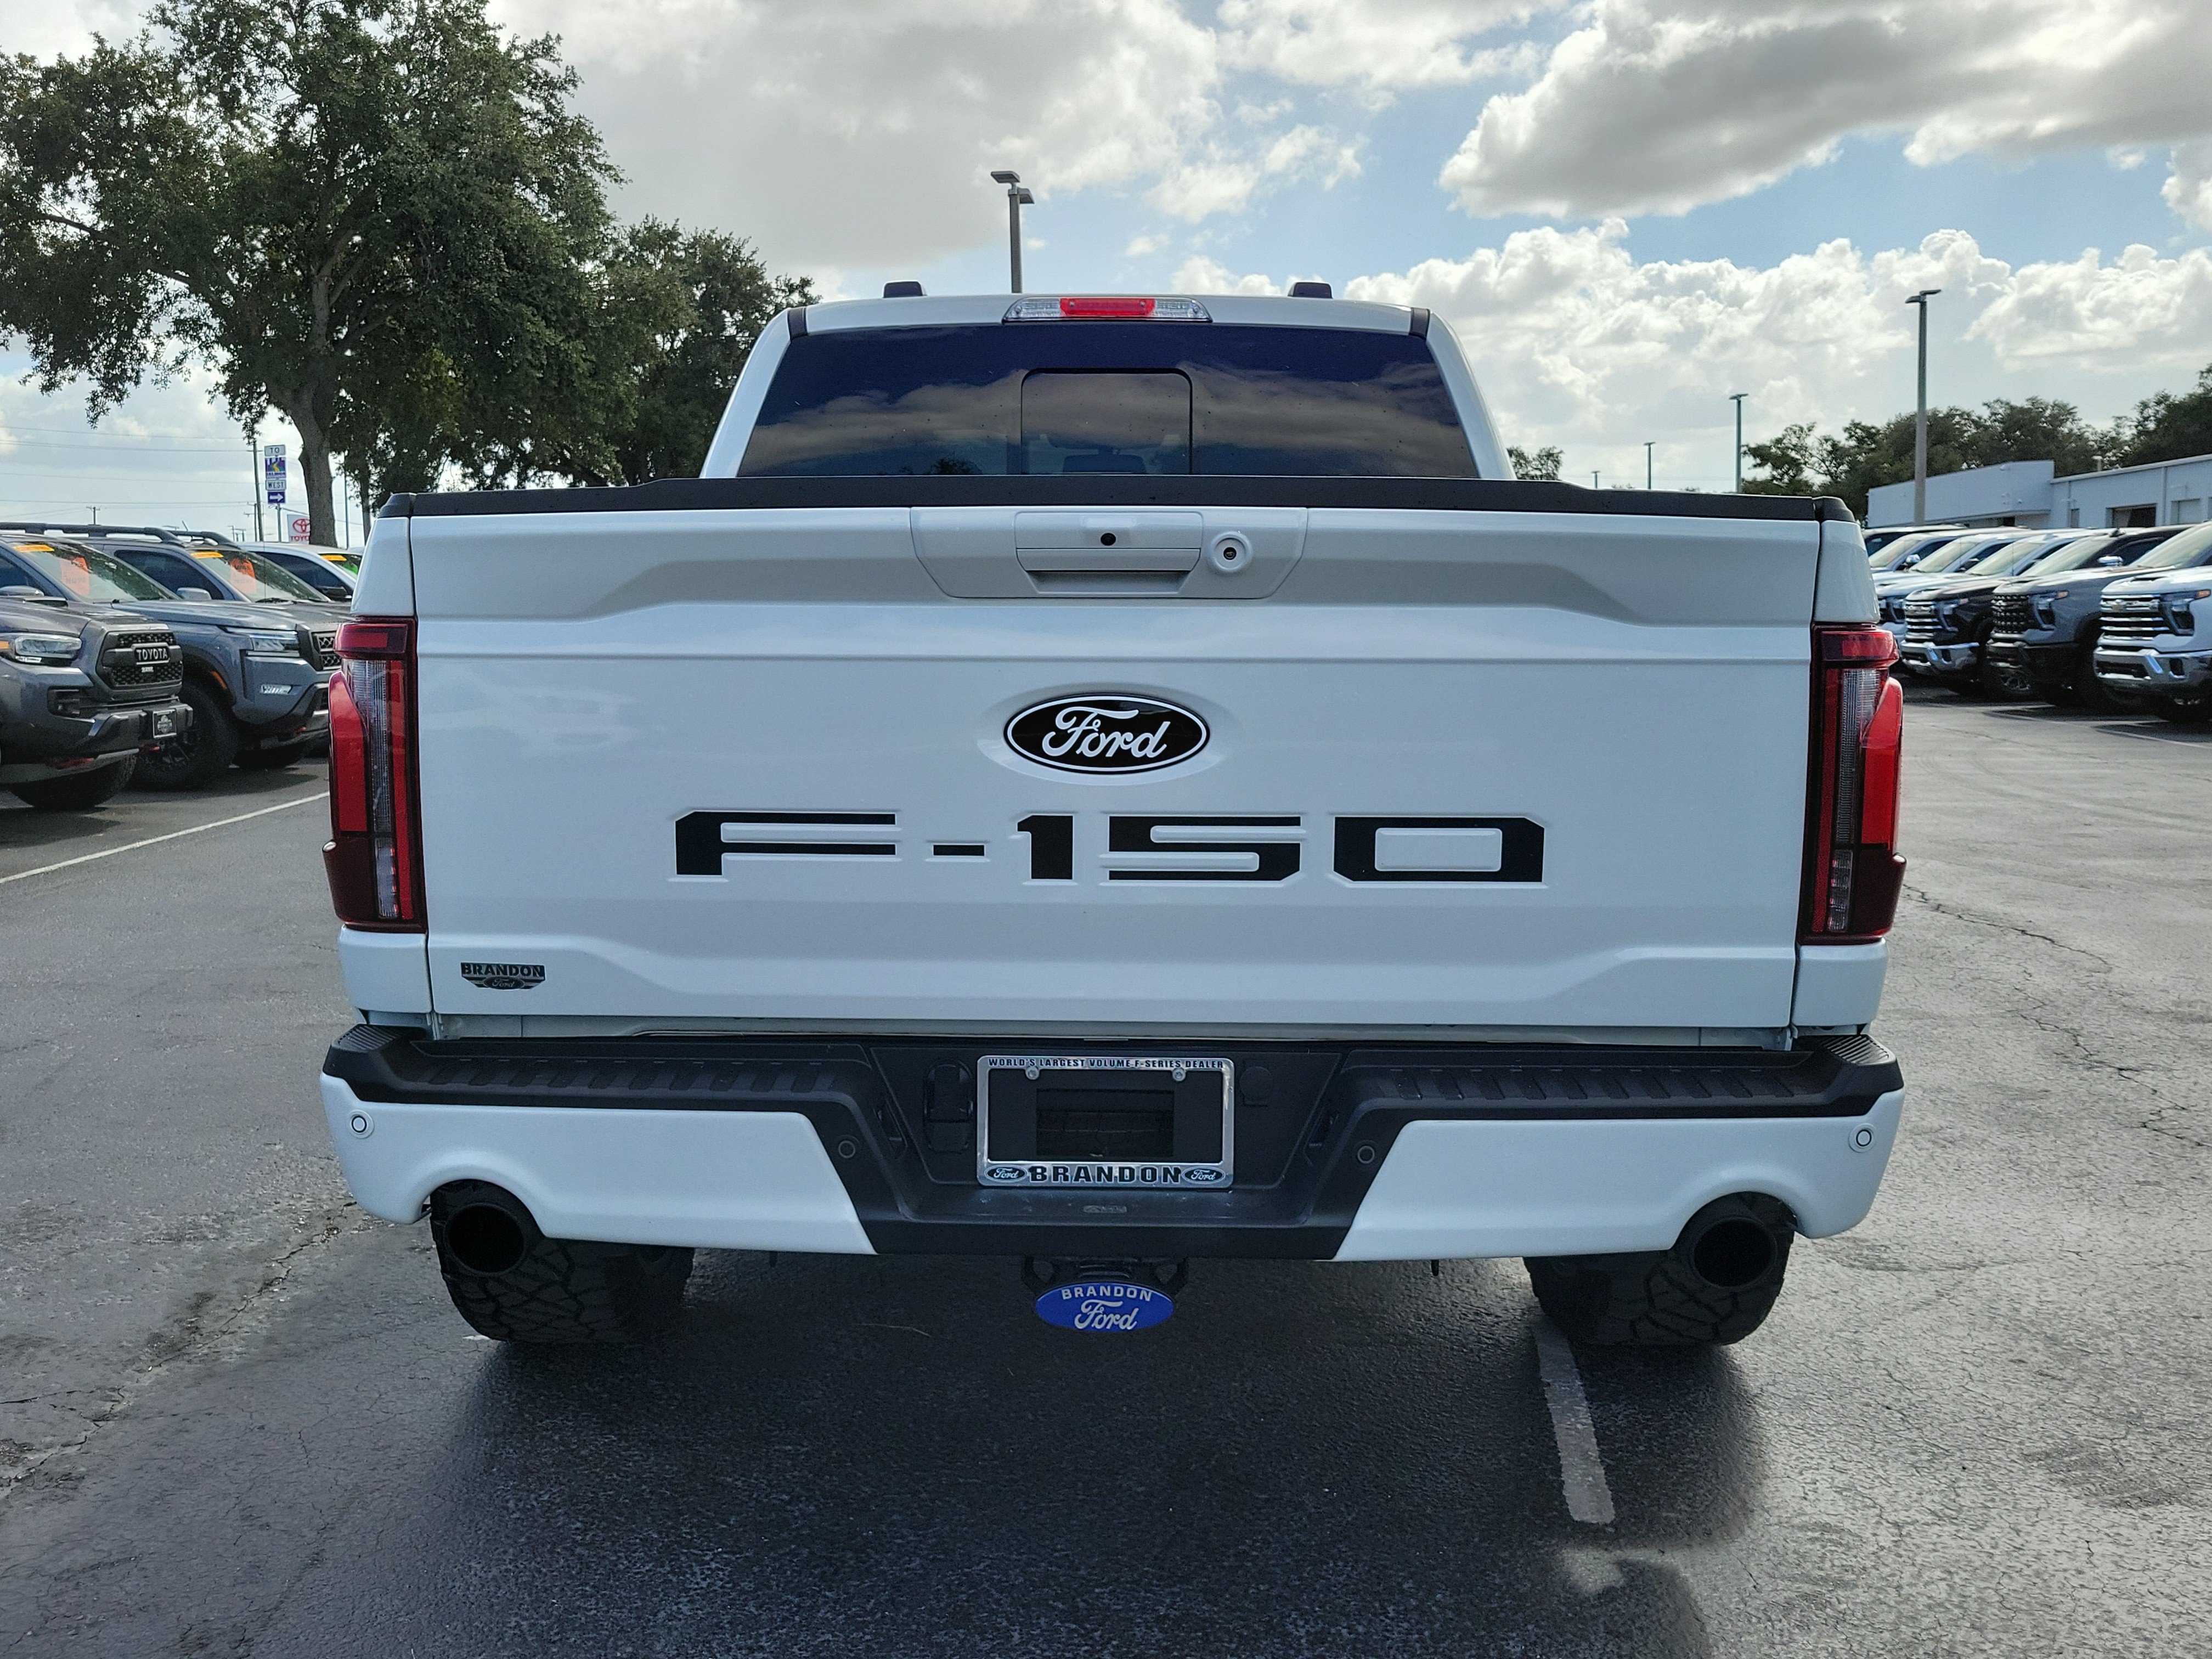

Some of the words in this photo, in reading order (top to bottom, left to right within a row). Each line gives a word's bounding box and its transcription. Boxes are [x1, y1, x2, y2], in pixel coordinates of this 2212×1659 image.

[136, 648, 168, 661] TOYOTA
[1042, 706, 1171, 758] Ford
[675, 811, 1545, 883] F-150
[461, 963, 543, 977] BRANDON
[492, 979, 516, 988] Ford
[989, 1058, 1036, 1066] WORLD'S
[1040, 1059, 1086, 1067] LARGEST
[1135, 1059, 1181, 1068] F-SERIES
[1185, 1060, 1223, 1069] DEALER
[994, 1167, 1019, 1179] Ford
[1029, 1165, 1181, 1183] BRANDON
[1190, 1169, 1216, 1180] Ford
[1062, 1285, 1152, 1302] BRANDON
[1074, 1299, 1139, 1330] Ford
